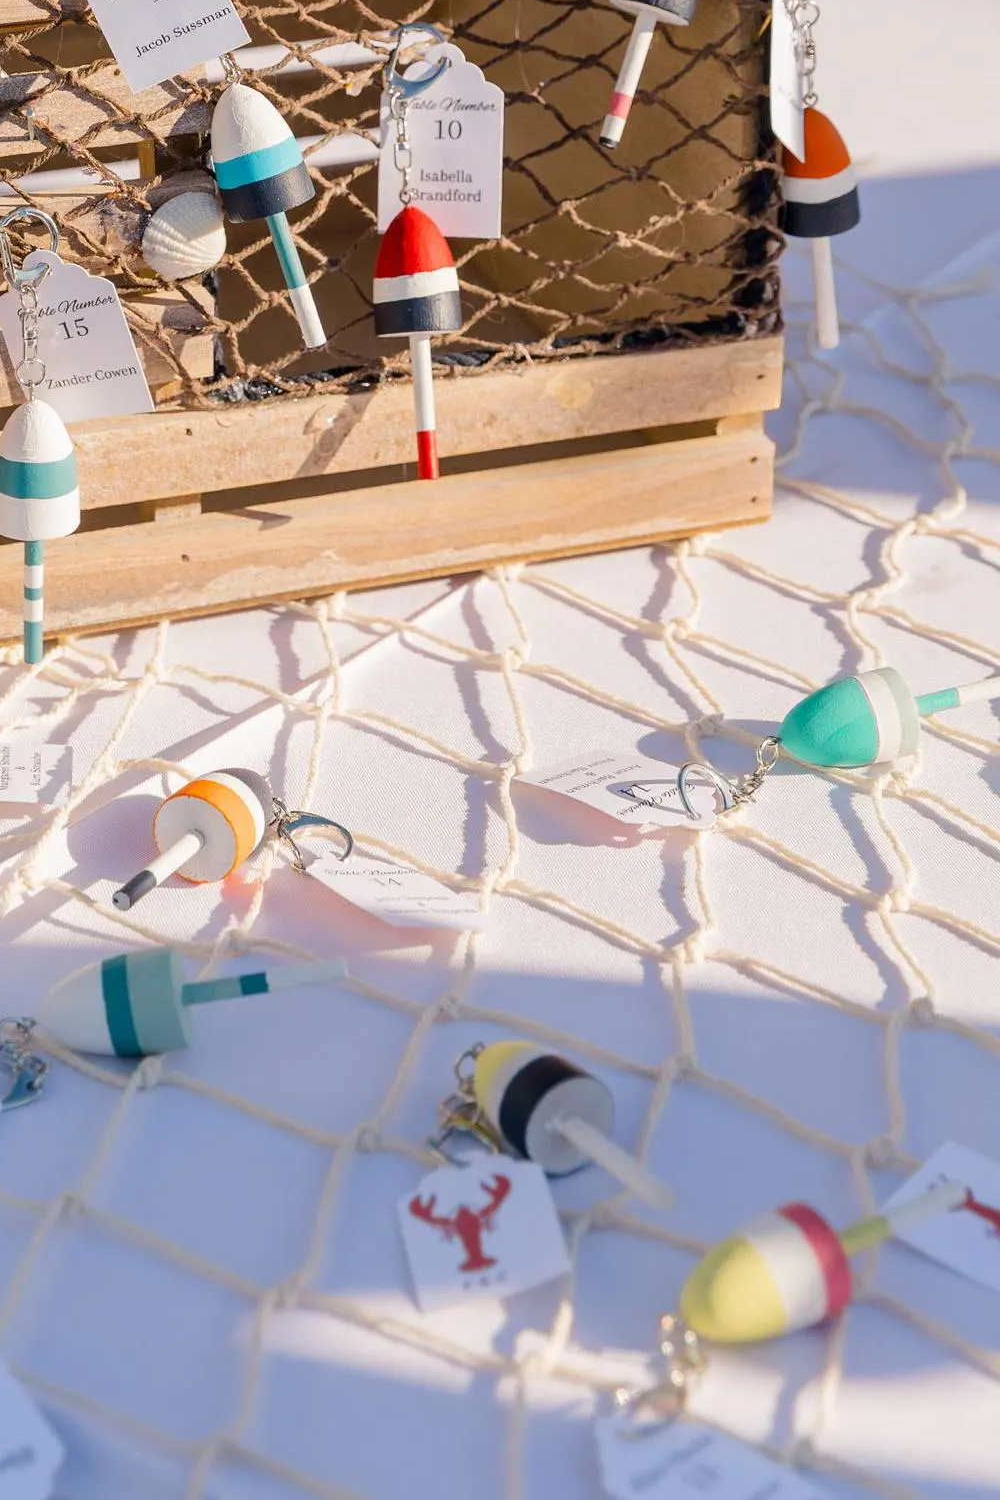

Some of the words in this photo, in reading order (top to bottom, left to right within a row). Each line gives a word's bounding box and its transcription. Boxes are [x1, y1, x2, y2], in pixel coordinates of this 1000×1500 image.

[135, 33, 171, 58] Jacob
[173, 6, 232, 38] Sussman
[407, 97, 437, 111] able
[440, 97, 498, 112] Number
[434, 120, 463, 140] 10
[420, 169, 473, 183] Isabella
[409, 187, 482, 203] Brandford
[58, 295, 116, 314] Number
[58, 316, 89, 341] 15
[44, 374, 92, 390] Zander
[94, 365, 138, 382] Cowen
[565, 774, 616, 794] Bachman
[618, 783, 651, 799] 14
[615, 794, 664, 817] Number
